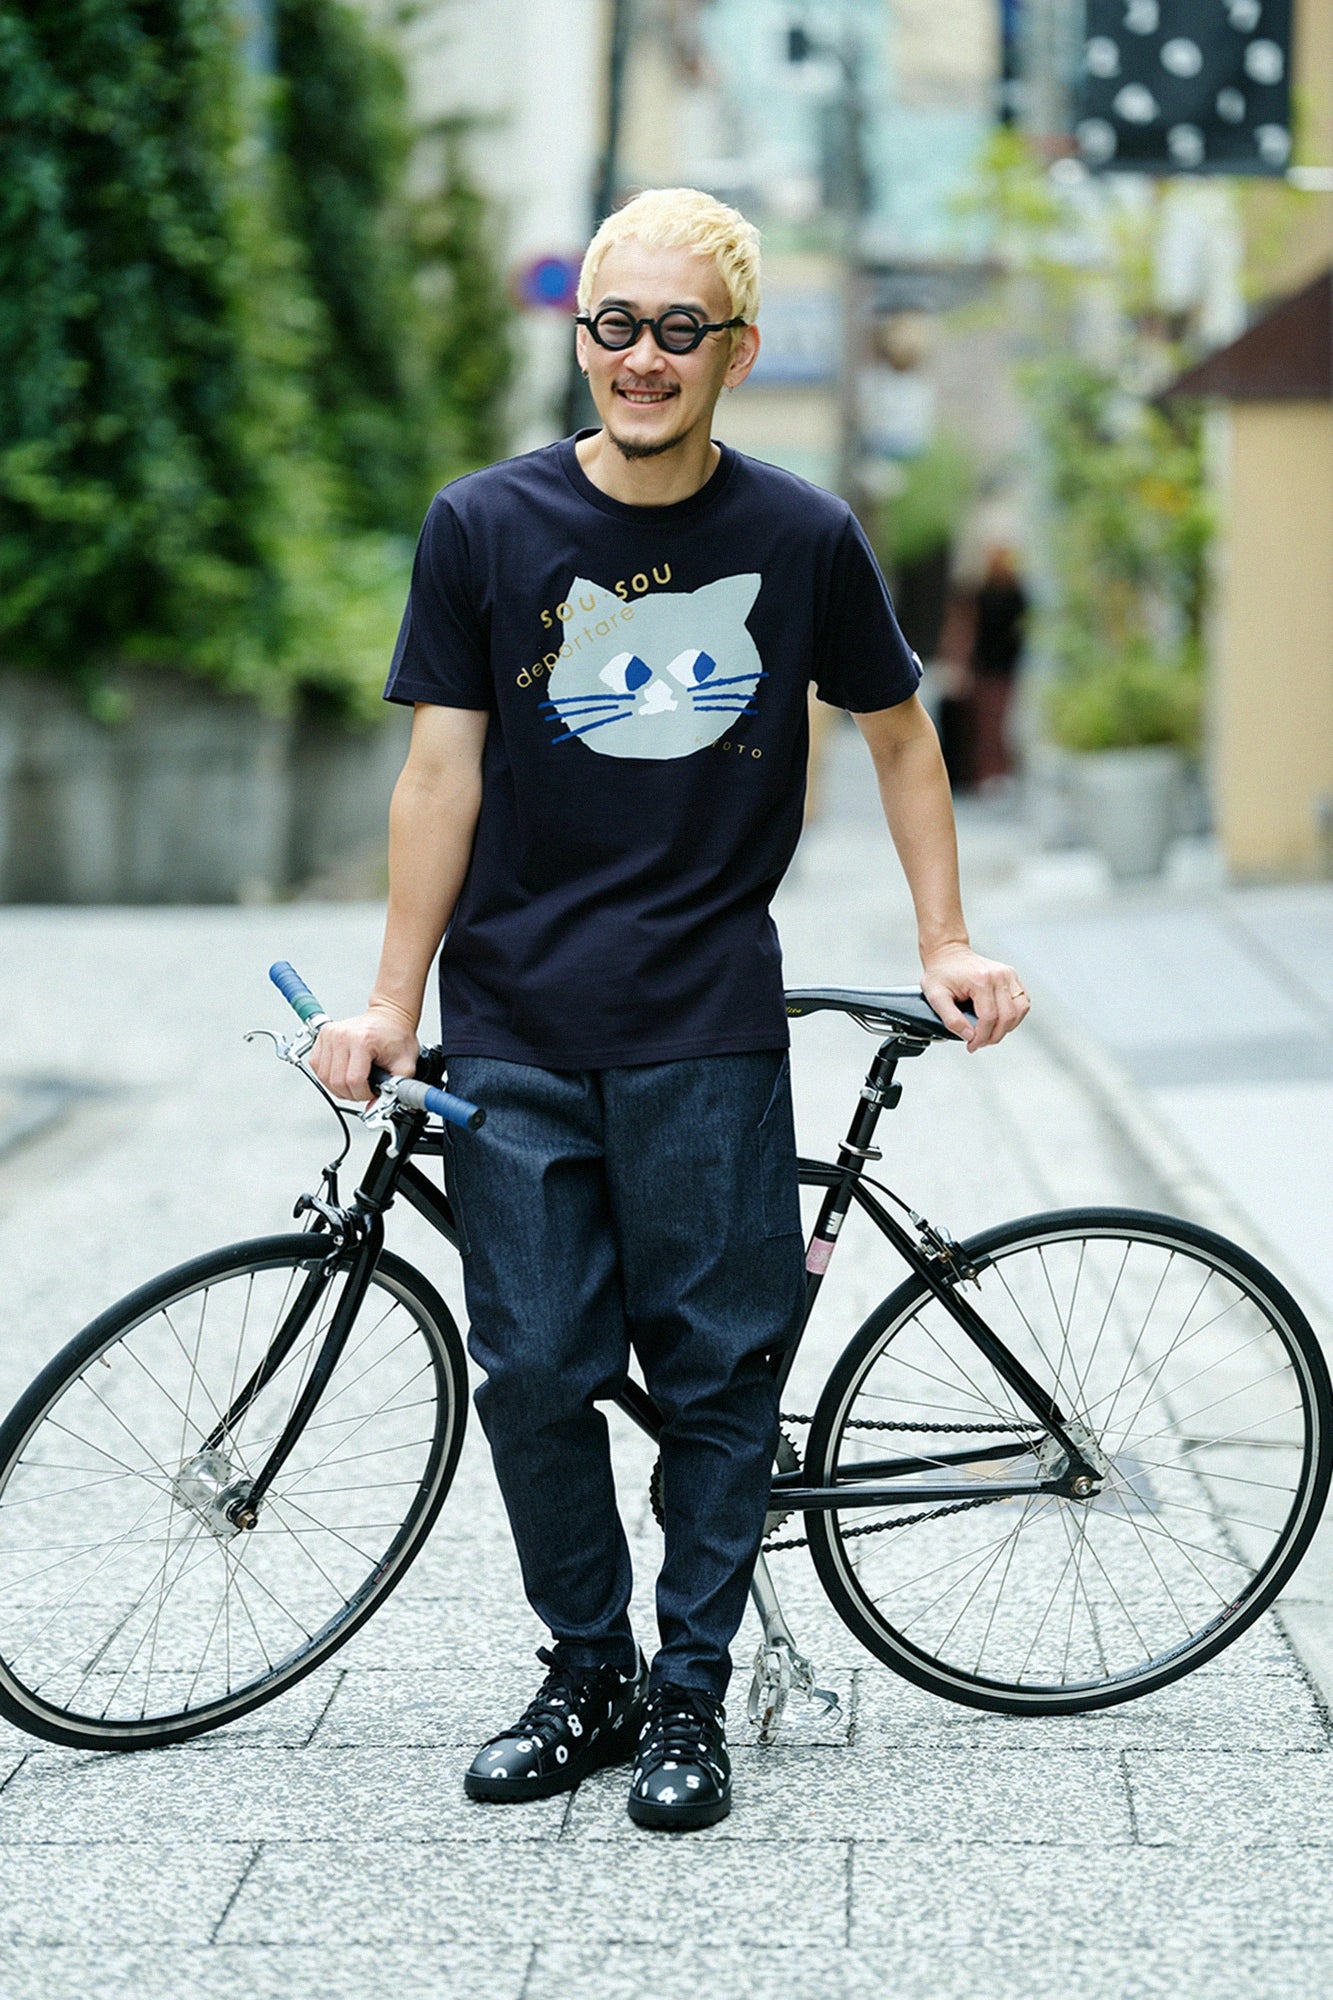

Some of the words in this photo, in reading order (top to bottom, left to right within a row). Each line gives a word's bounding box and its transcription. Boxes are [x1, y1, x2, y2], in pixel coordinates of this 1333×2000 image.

[515, 605, 636, 689] deportare
[567, 1713, 583, 1738] 8
[555, 1744, 569, 1765] 0
[685, 1774, 701, 1789] 5
[656, 1786, 679, 1805] 4
